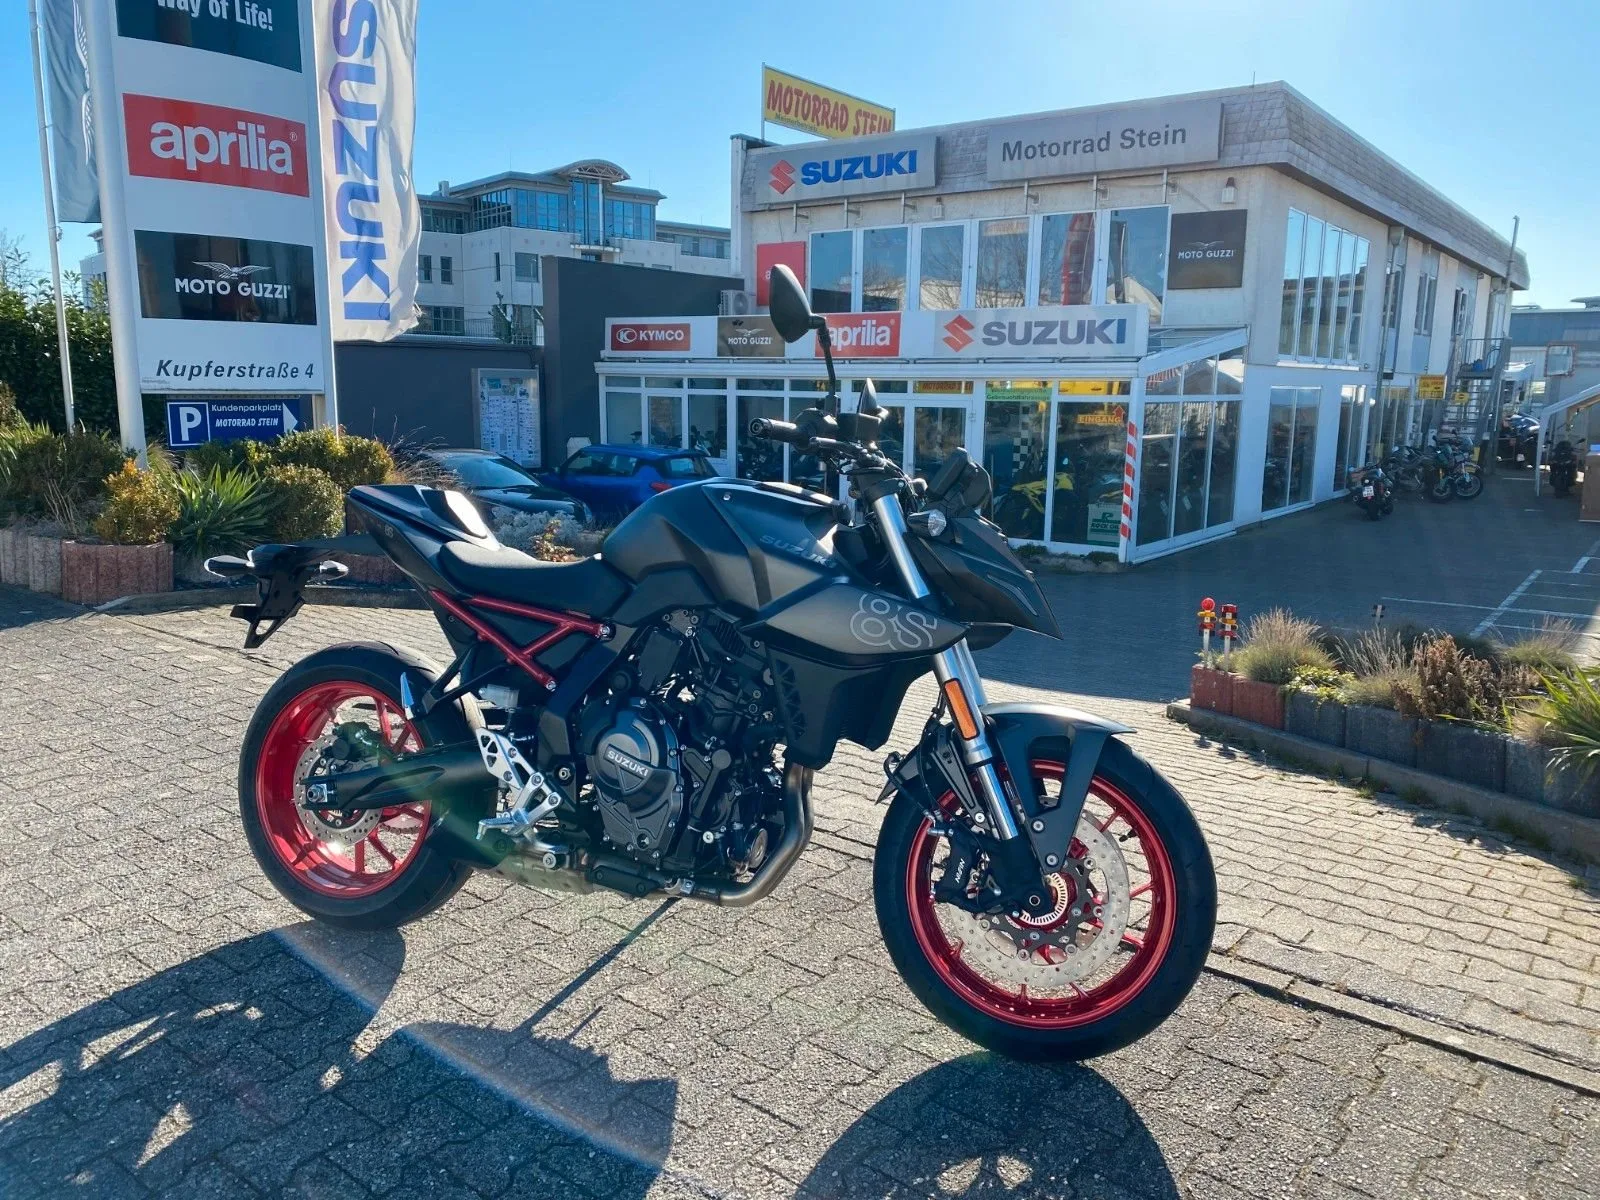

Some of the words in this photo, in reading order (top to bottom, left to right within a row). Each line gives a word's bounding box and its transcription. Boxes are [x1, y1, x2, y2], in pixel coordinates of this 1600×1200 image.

[208, 0, 228, 19] of
[234, 0, 273, 31] Life!
[766, 80, 849, 132] MOTORRAD
[852, 109, 892, 135] STEIN
[150, 120, 293, 176] aprilia
[1002, 130, 1110, 163] Motorrad
[1119, 124, 1187, 151] Stein
[328, 0, 391, 321] SUZUKI
[801, 149, 918, 186] SUZUKI
[1178, 250, 1203, 259] MOTO
[1206, 249, 1234, 258] GUZZI
[175, 278, 230, 295] MOTO
[237, 281, 288, 299] GUZZI
[639, 329, 685, 342] KYMCO
[728, 337, 747, 345] MOTO
[749, 337, 772, 345] GUZZI
[828, 319, 891, 352] aprilia
[981, 318, 1127, 346] SUZUKI
[156, 359, 299, 381] Kupferstraße
[304, 363, 314, 379] 4
[211, 404, 282, 413] Kundenparkplatz
[215, 418, 256, 428] MOTORRAD
[257, 417, 279, 427] STEIN
[1079, 415, 1121, 423] EINGANG
[179, 406, 202, 442] P
[759, 533, 838, 570] SUZUKI
[607, 750, 649, 777] SUZUKI
